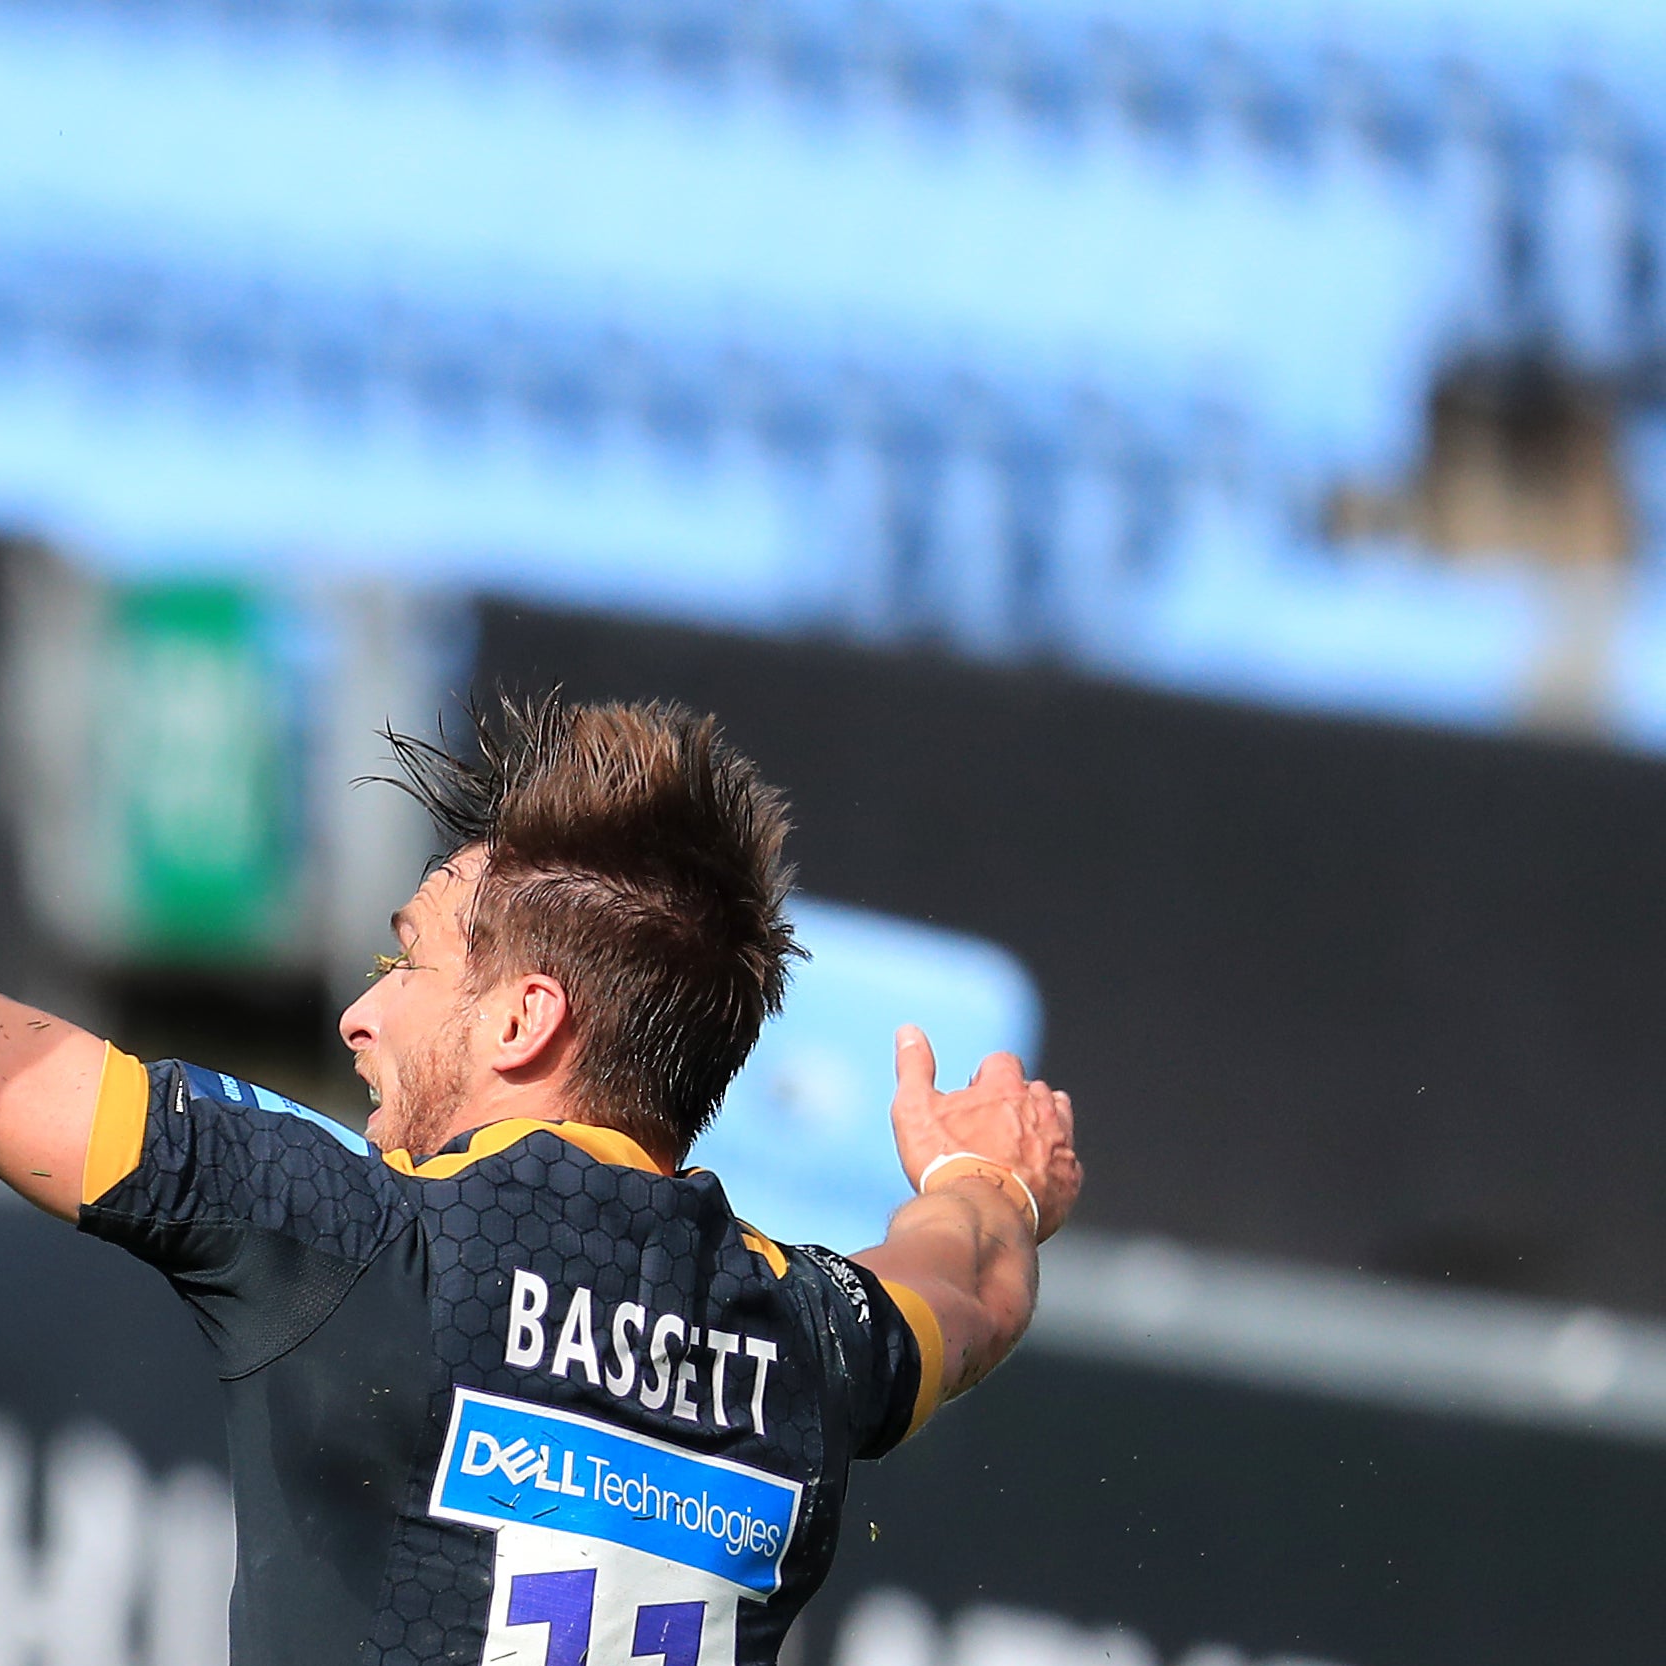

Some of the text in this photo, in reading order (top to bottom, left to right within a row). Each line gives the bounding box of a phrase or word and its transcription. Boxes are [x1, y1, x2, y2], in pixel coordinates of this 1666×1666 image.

[504, 1266, 777, 1434] BASSETT
[460, 1429, 782, 1559] DELL Technologies
